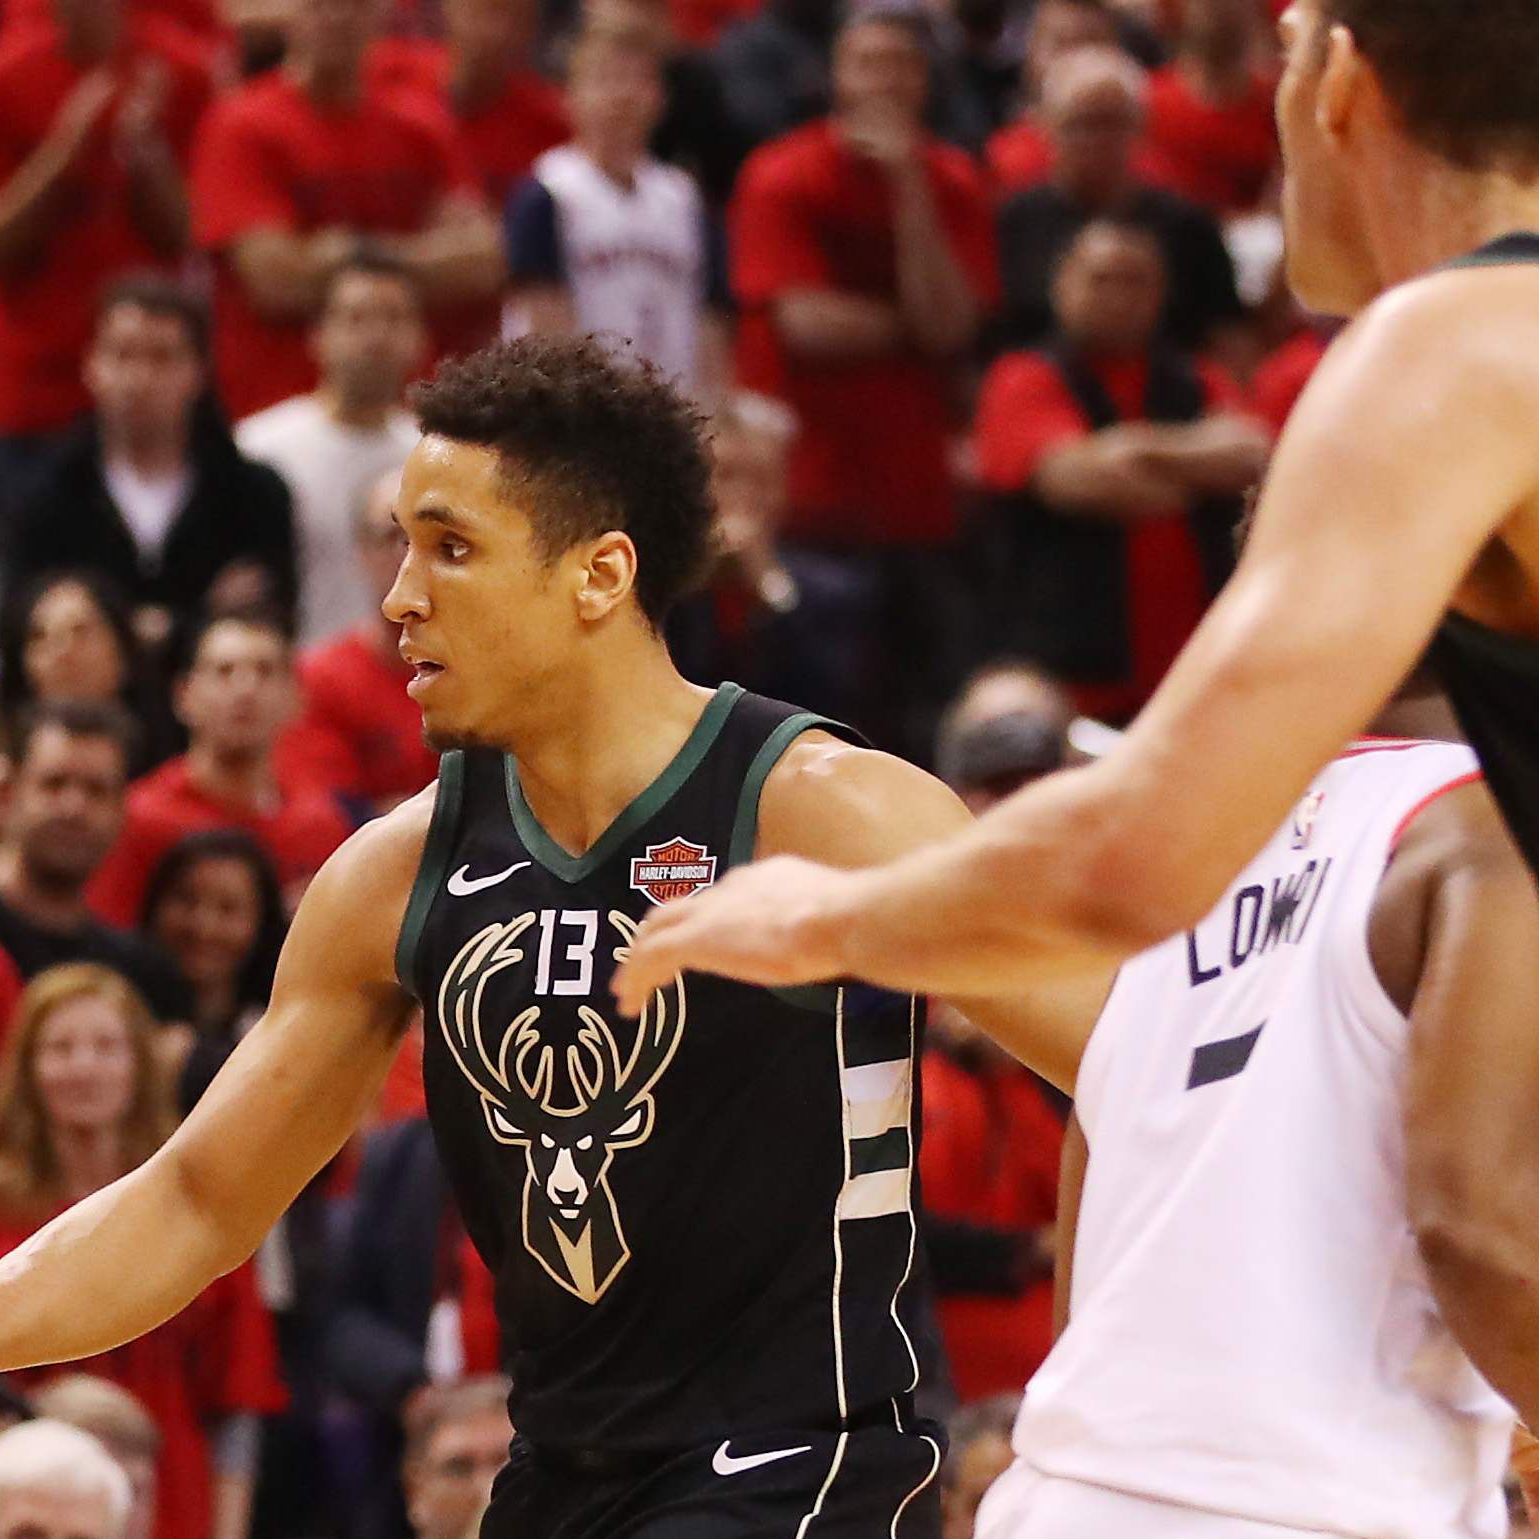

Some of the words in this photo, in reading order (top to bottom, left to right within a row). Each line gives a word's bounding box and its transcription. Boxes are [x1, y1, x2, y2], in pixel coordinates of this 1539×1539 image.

[658, 848, 696, 862] MOTOR
[638, 865, 710, 881] HARLEY-DAVIDSON
[534, 908, 599, 997] 13
